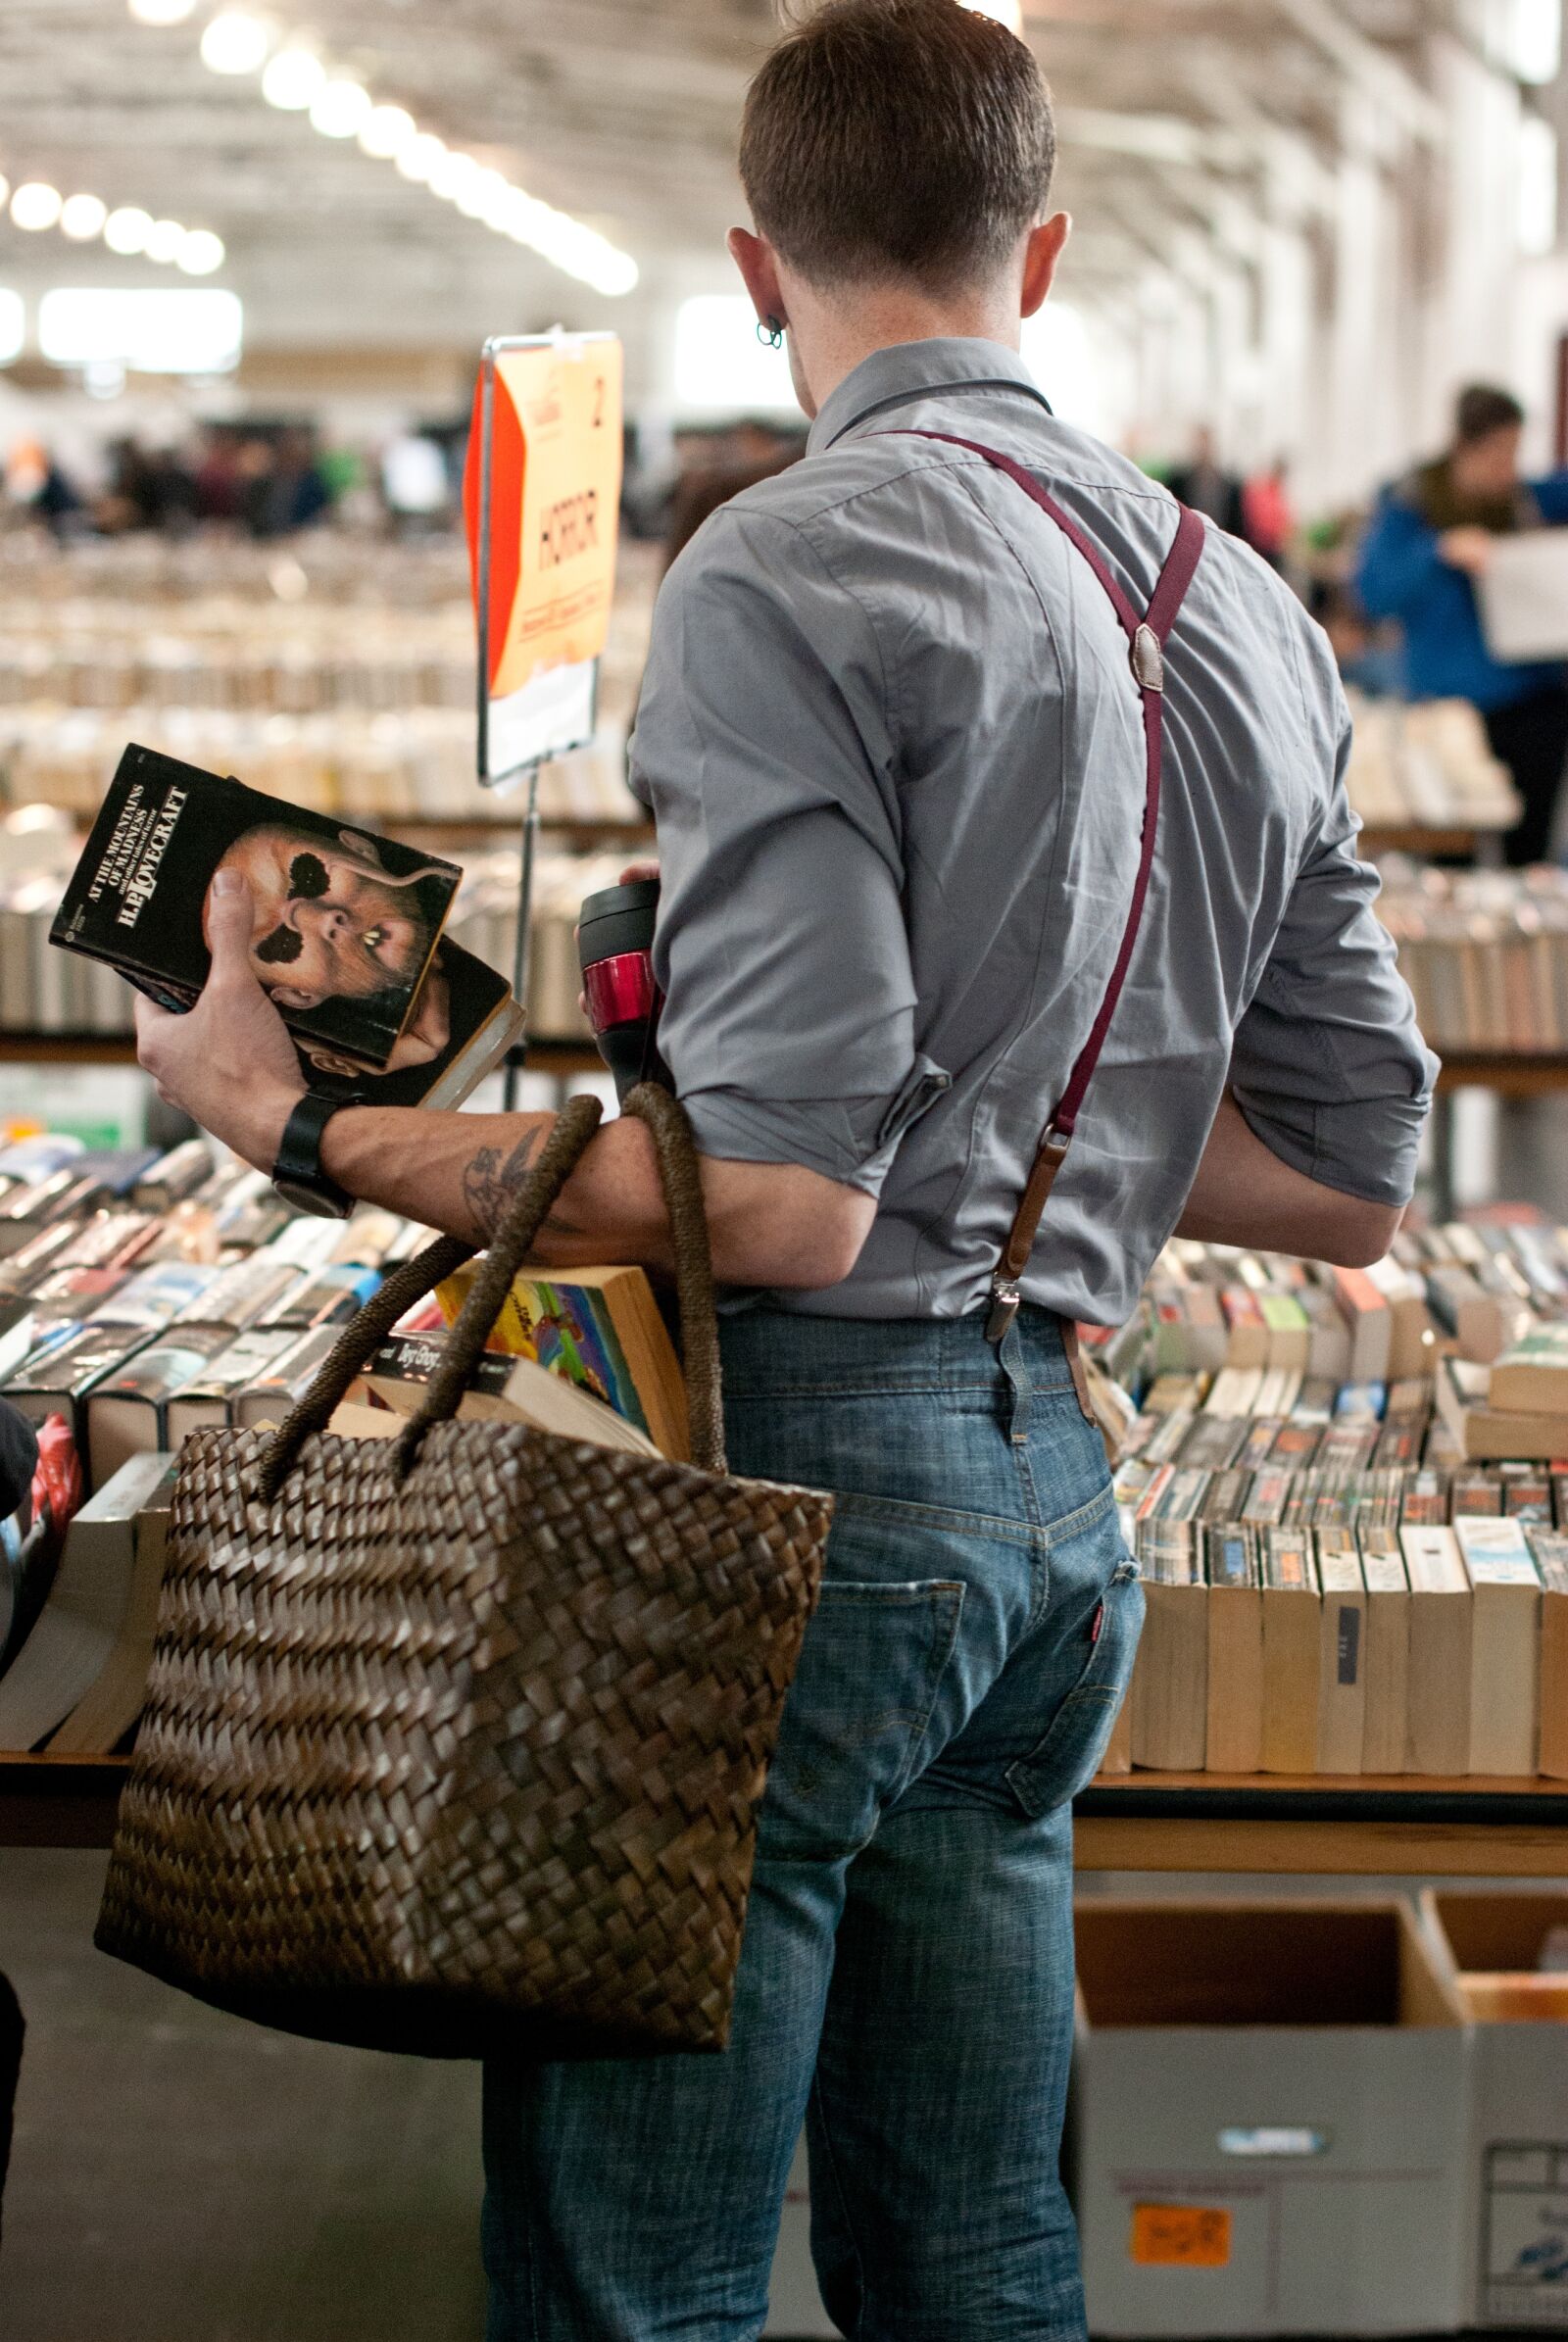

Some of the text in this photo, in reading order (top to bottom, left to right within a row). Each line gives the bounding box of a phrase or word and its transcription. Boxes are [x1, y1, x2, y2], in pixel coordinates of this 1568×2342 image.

[107, 785, 143, 856] MOUNTAINS
[109, 809, 147, 886] OF MADNESS
[118, 787, 187, 927] H.P. LOVECRAFT
[119, 879, 130, 895] and
[125, 858, 136, 879] other
[132, 841, 144, 858] tales
[144, 808, 157, 831] terror
[88, 884, 102, 902] AT
[94, 857, 115, 883] THE
